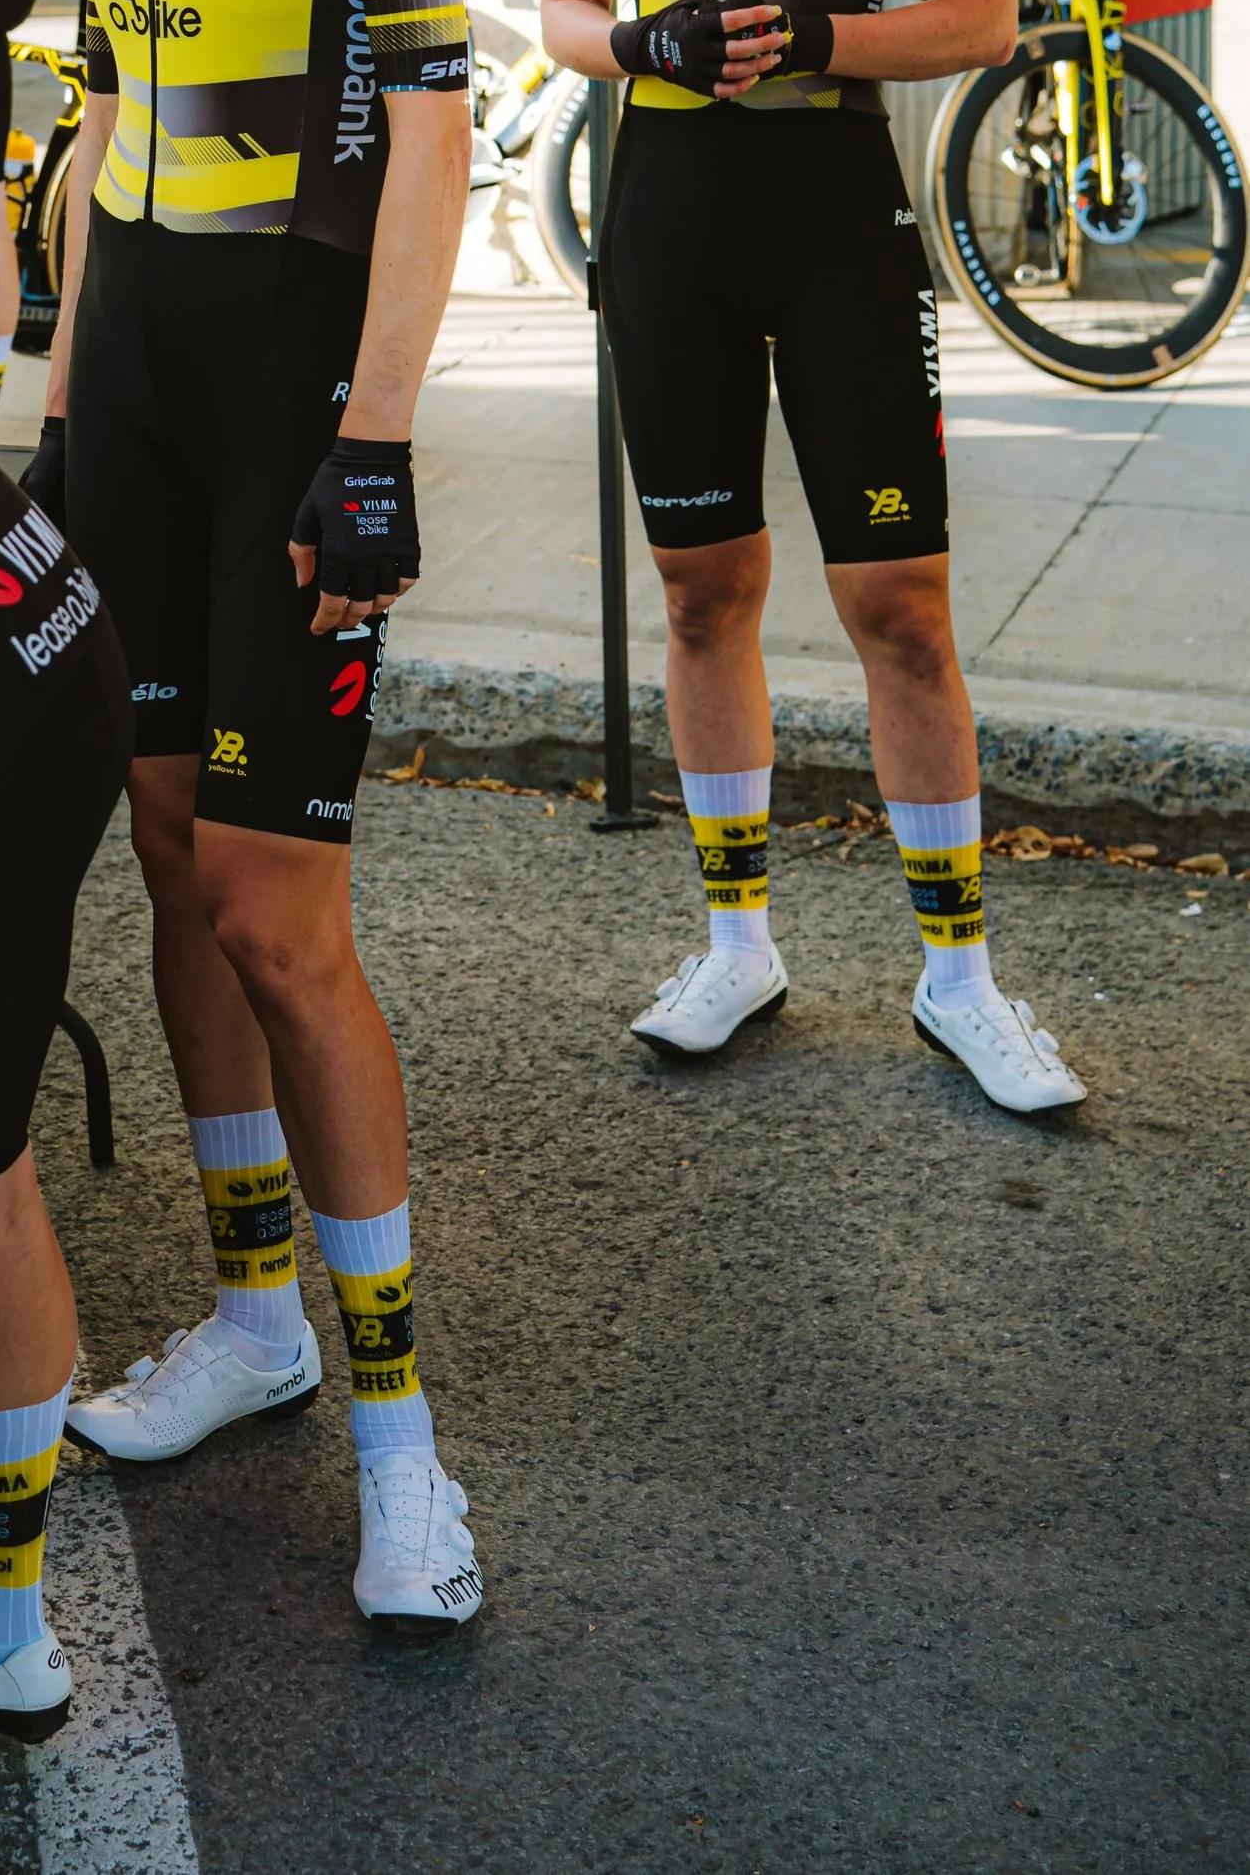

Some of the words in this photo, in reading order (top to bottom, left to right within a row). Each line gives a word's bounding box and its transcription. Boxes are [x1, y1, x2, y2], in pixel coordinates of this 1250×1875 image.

[917, 289, 942, 398] VISMA
[344, 475, 395, 488] GripGrab
[362, 499, 398, 511] VISMA
[641, 490, 733, 509] cervélo
[356, 514, 388, 526] lease
[207, 763, 235, 776] yellow
[904, 859, 954, 875] VISMA
[255, 1206, 291, 1223] lease
[259, 1249, 293, 1274] nimbl
[266, 1365, 306, 1402] nimbl
